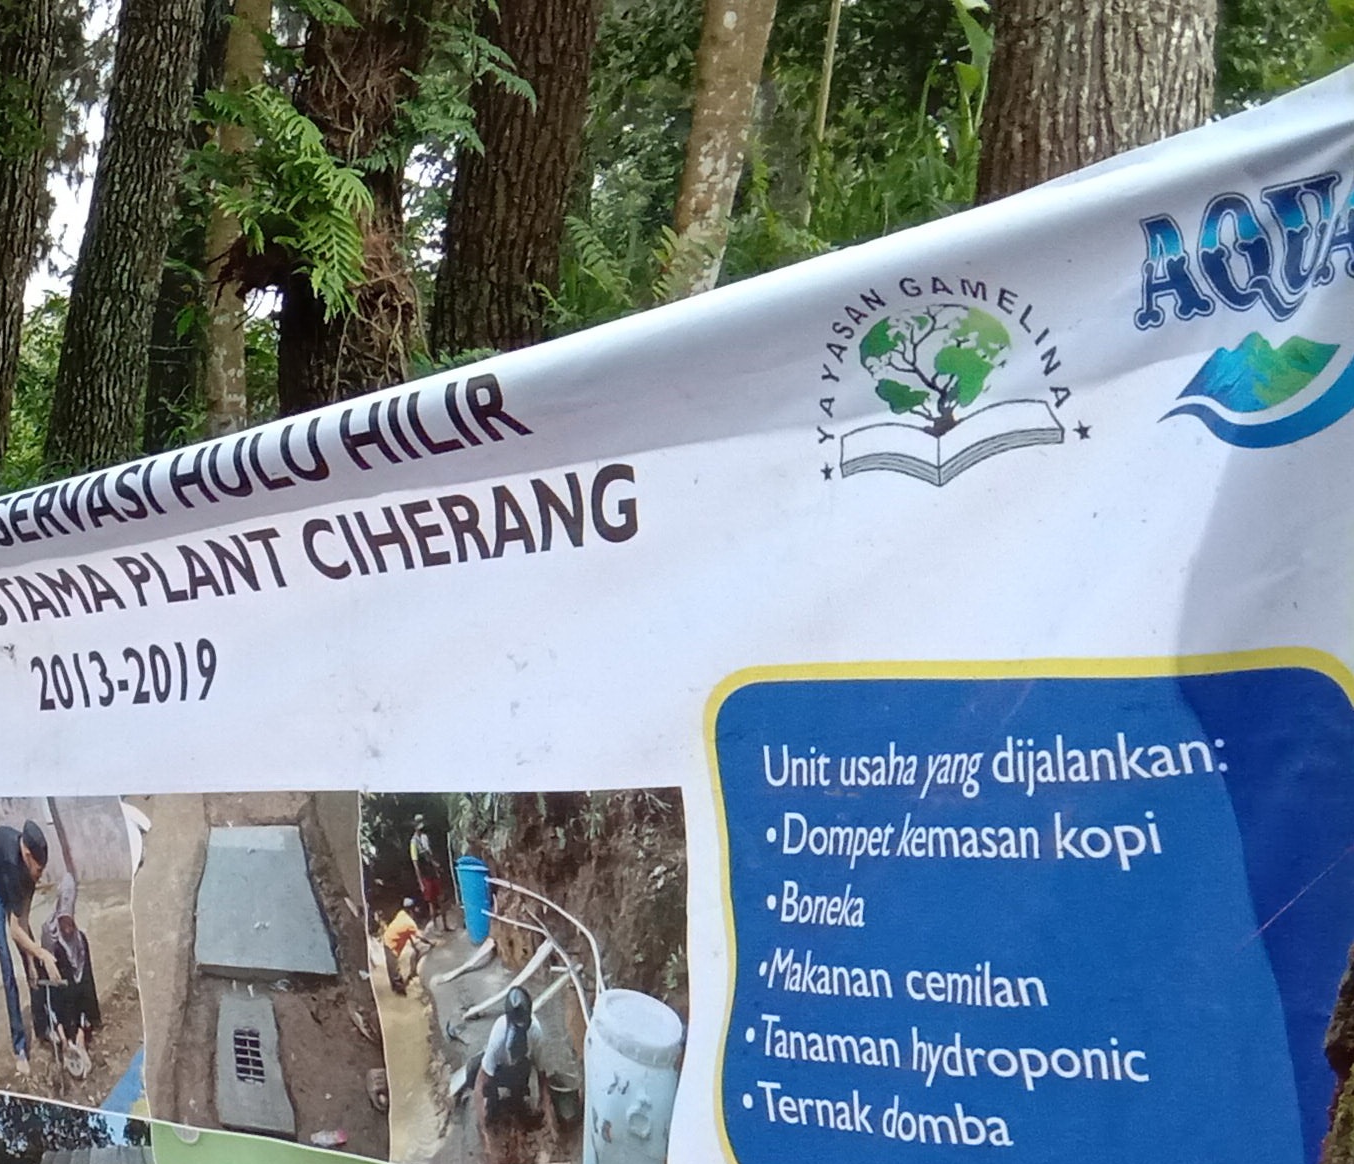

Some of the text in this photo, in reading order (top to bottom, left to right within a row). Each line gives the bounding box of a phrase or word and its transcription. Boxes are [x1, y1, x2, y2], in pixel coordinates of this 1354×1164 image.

[817, 275, 1072, 445] YAYASAN GAMELINA
[169, 416, 331, 509] HULU
[338, 373, 534, 471] HILIR
[113, 527, 288, 607] PLANT
[302, 463, 639, 580] CIHERANG
[31, 637, 217, 711] 2013-2019
[762, 732, 1229, 799] Unit usaha yang dijalankan:
[781, 811, 1163, 872] Dompet kemasan kopi
[780, 880, 866, 929] Boneka
[766, 948, 1049, 1007] Makanan cemilan
[761, 1014, 1151, 1090] Tanaman hydroponic
[757, 1081, 1014, 1147] Ternak domba
